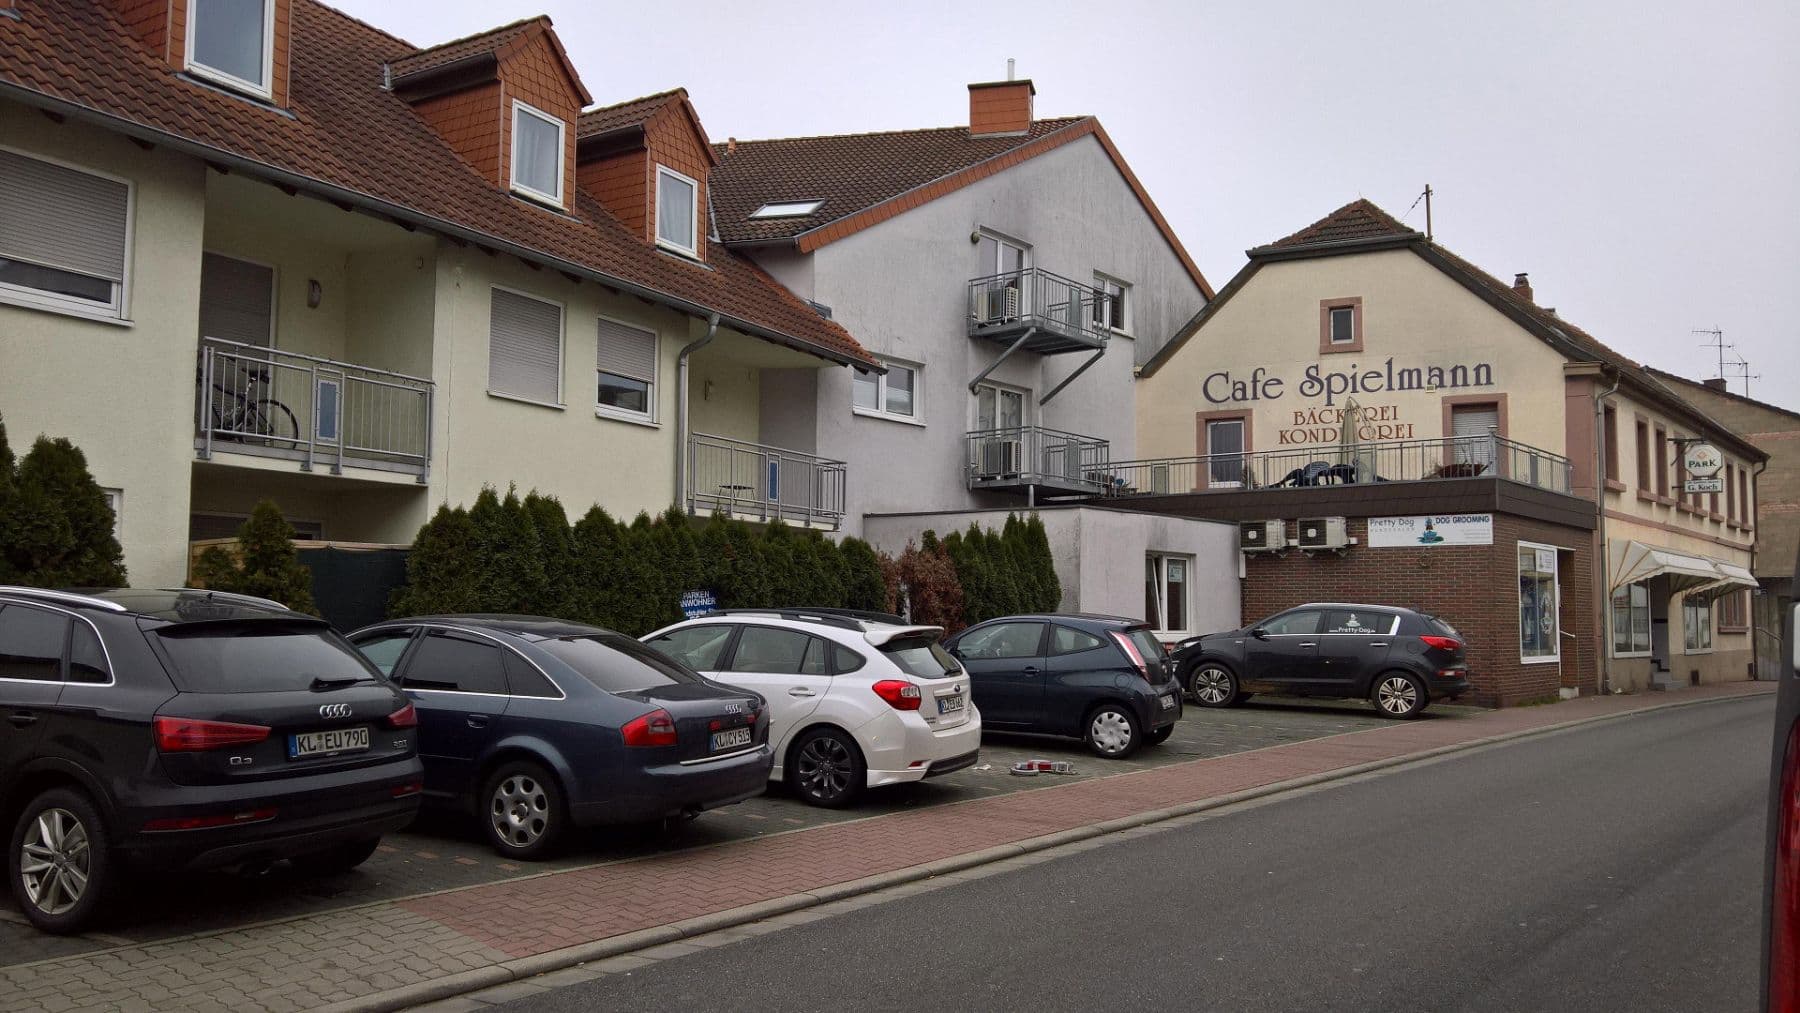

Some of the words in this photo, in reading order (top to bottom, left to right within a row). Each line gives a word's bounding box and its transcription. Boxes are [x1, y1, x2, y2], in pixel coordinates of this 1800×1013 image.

[1202, 367, 1284, 404] Cafe
[1299, 357, 1495, 406] Spielmann
[1278, 424, 1414, 445] KONDOREI
[1688, 459, 1717, 468] PARK
[1369, 519, 1396, 528] Pretty
[1398, 518, 1415, 527] Dog
[1452, 515, 1490, 524] GROOMING
[683, 590, 710, 599] PARKEN
[297, 735, 316, 753] KL
[325, 732, 343, 749] EU
[344, 729, 368, 746] 790
[716, 734, 726, 747] KL
